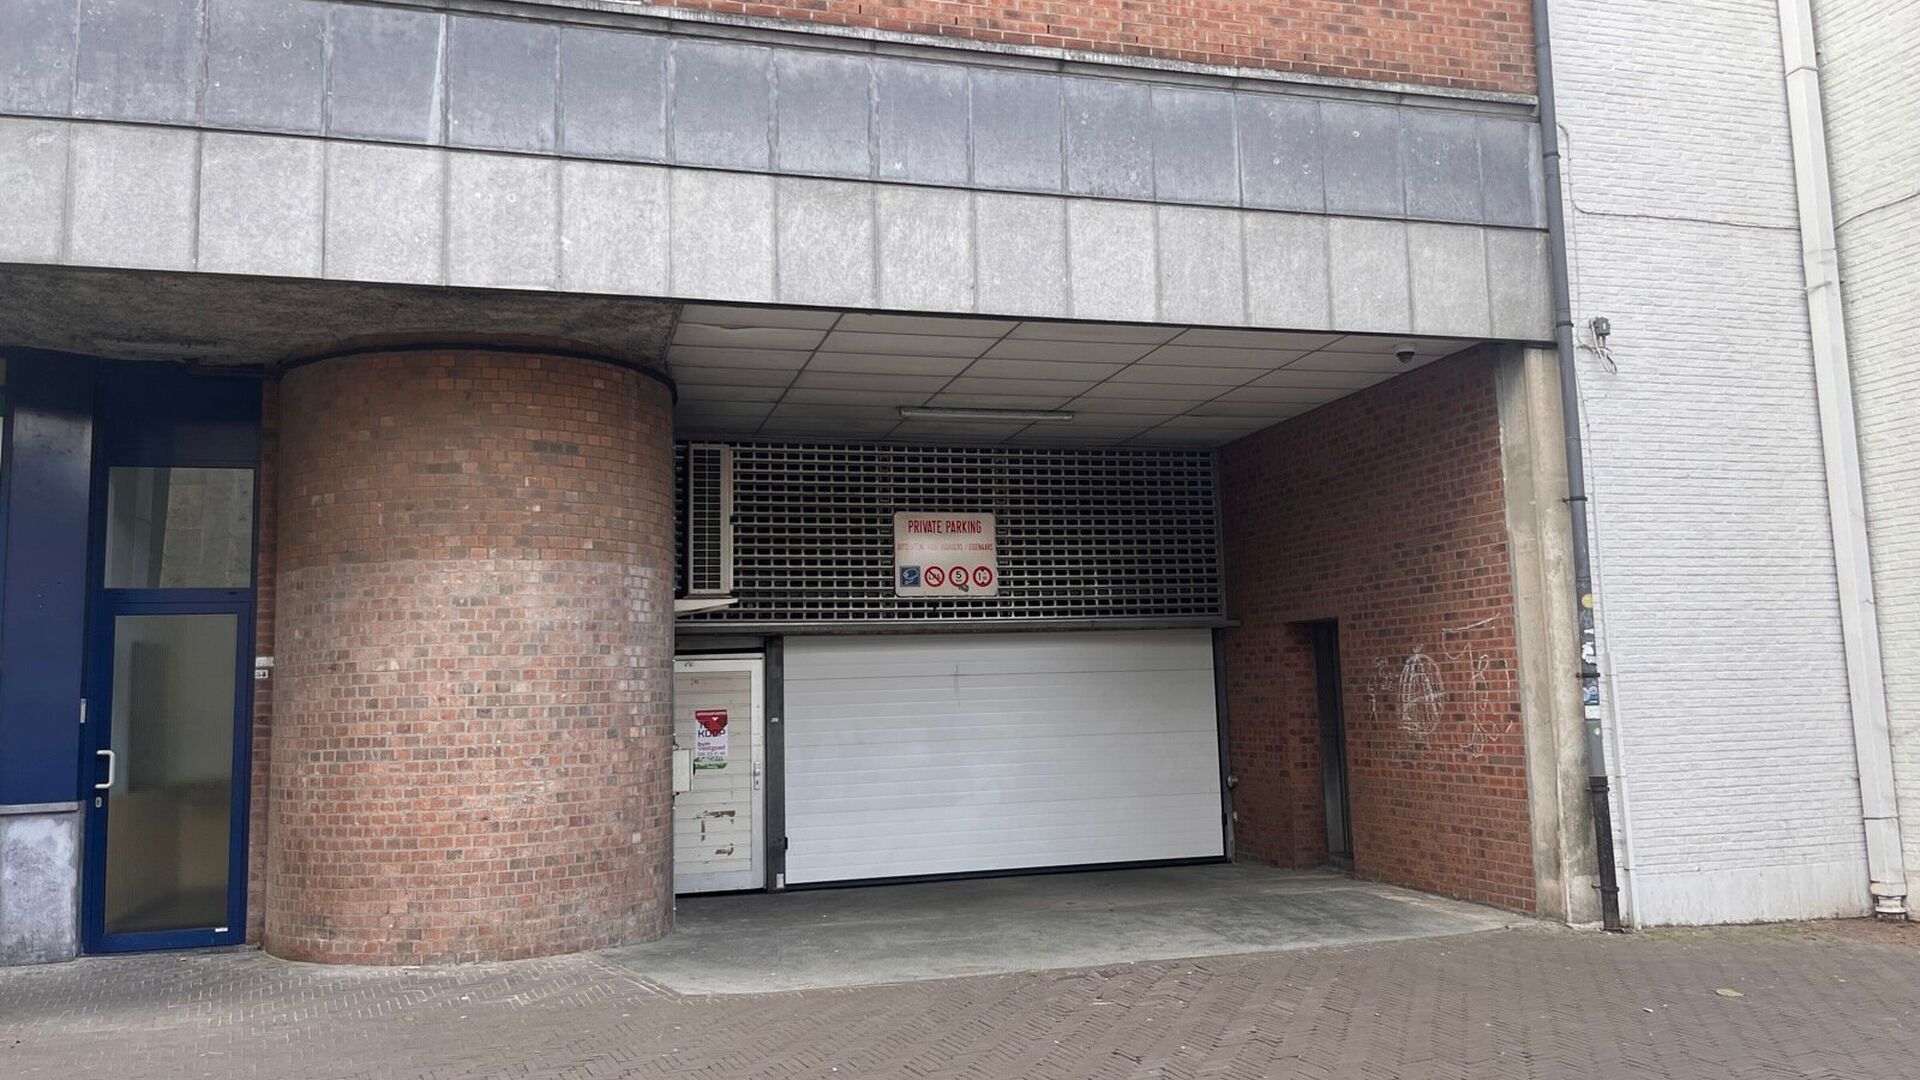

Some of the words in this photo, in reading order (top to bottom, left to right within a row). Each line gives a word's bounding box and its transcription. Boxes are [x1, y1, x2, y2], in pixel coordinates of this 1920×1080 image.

[908, 520, 942, 534] PRIVATE
[946, 520, 982, 534] PARKING
[956, 570, 962, 579] 5
